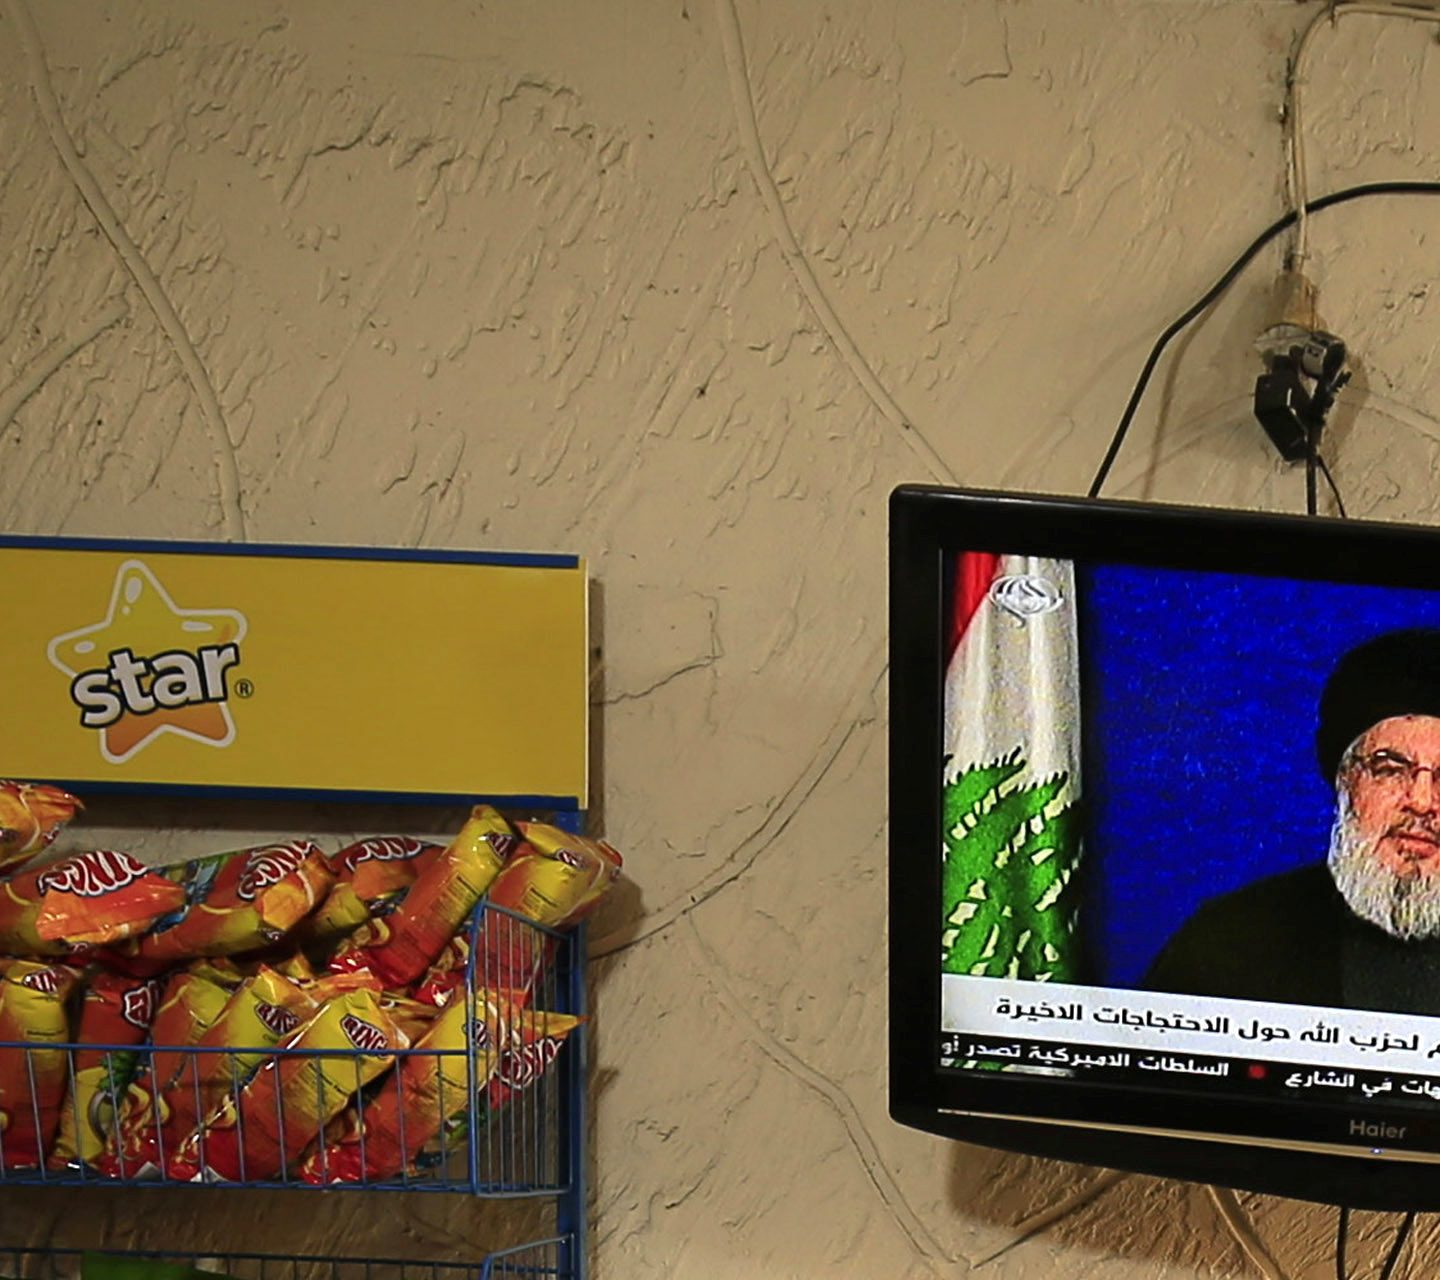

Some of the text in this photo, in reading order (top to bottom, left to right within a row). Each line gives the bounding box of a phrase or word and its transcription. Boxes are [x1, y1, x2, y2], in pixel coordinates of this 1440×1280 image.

[71, 648, 240, 728] star
[996, 997, 1083, 1023] الاخيرة
[1093, 1006, 1229, 1035] الاحتجاجات
[1238, 1019, 1291, 1042] حول
[1300, 1021, 1339, 1044] الله
[965, 1042, 1022, 1059] تصدر
[1349, 1032, 1418, 1054] لحزب
[1028, 1045, 1130, 1069] الاميركية
[1138, 1053, 1229, 1077] السلطات
[1285, 1071, 1355, 1089] الشارع
[1361, 1077, 1393, 1098] في
[1349, 1120, 1407, 1138] Haier
